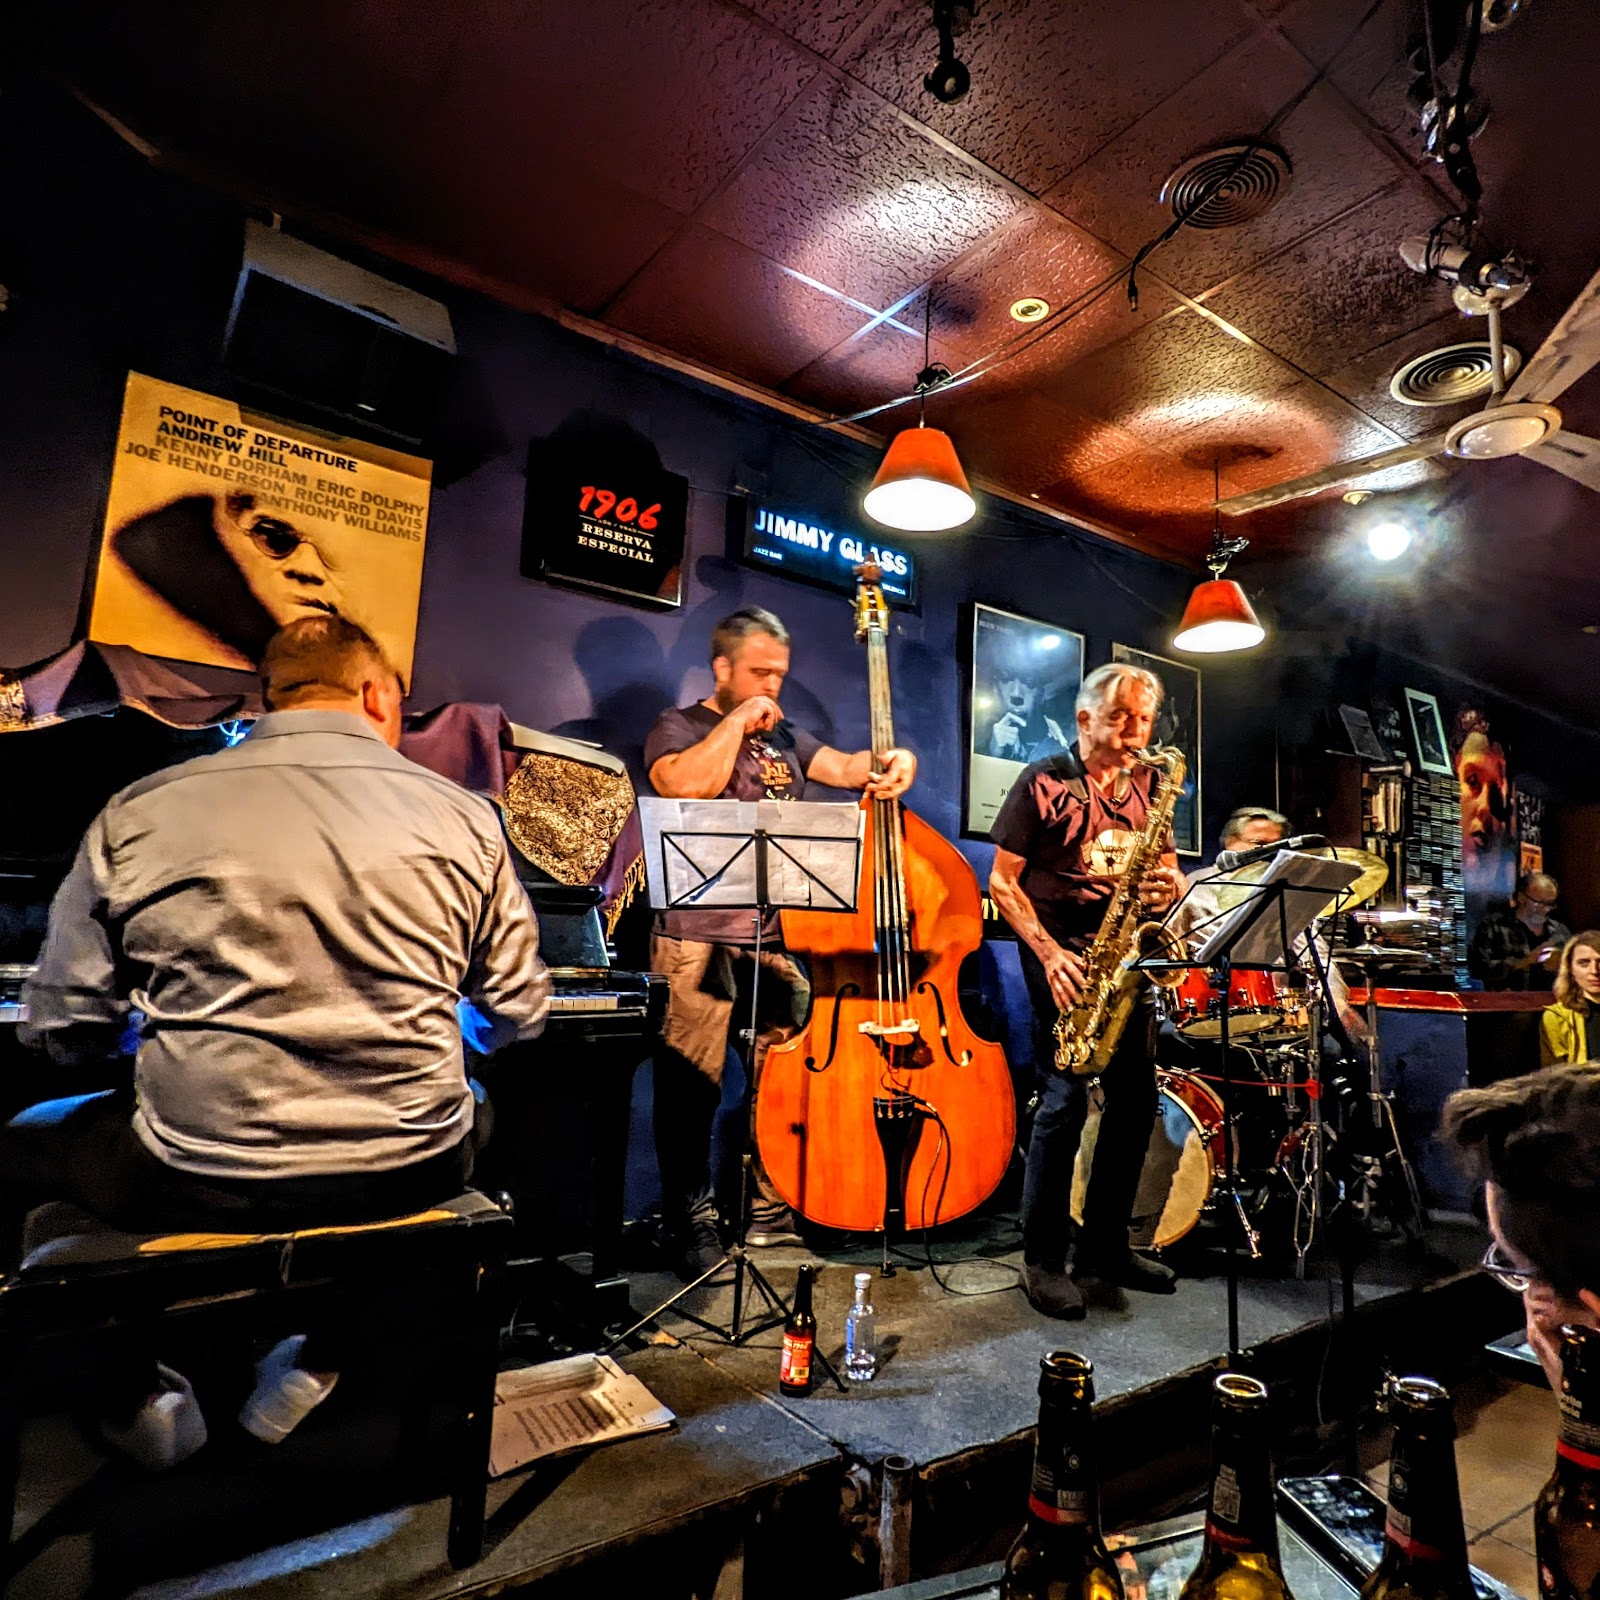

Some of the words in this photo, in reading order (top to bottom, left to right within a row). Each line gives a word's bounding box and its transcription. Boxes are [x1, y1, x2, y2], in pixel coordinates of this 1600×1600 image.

[157, 421, 243, 454] ANDREW
[248, 445, 288, 467] HILL
[159, 405, 219, 432] POINT
[223, 424, 248, 440] OF
[254, 432, 358, 473] DEPARTURE
[124, 441, 161, 462] JOE
[167, 453, 286, 494] HENDERSON
[295, 487, 371, 516] RICHARD
[375, 508, 423, 530] DAVIS
[155, 434, 223, 462] KENNY
[228, 454, 308, 486] DORHAM
[316, 478, 356, 499] ERIC
[360, 490, 424, 517] DOLPHY
[259, 492, 340, 522] ANTHONY
[343, 515, 422, 542] WILLIAMS
[579, 486, 662, 530] 1906
[754, 509, 835, 553] JIMMY
[577, 535, 654, 563] ESPECIAL
[582, 522, 652, 550] RESERVA
